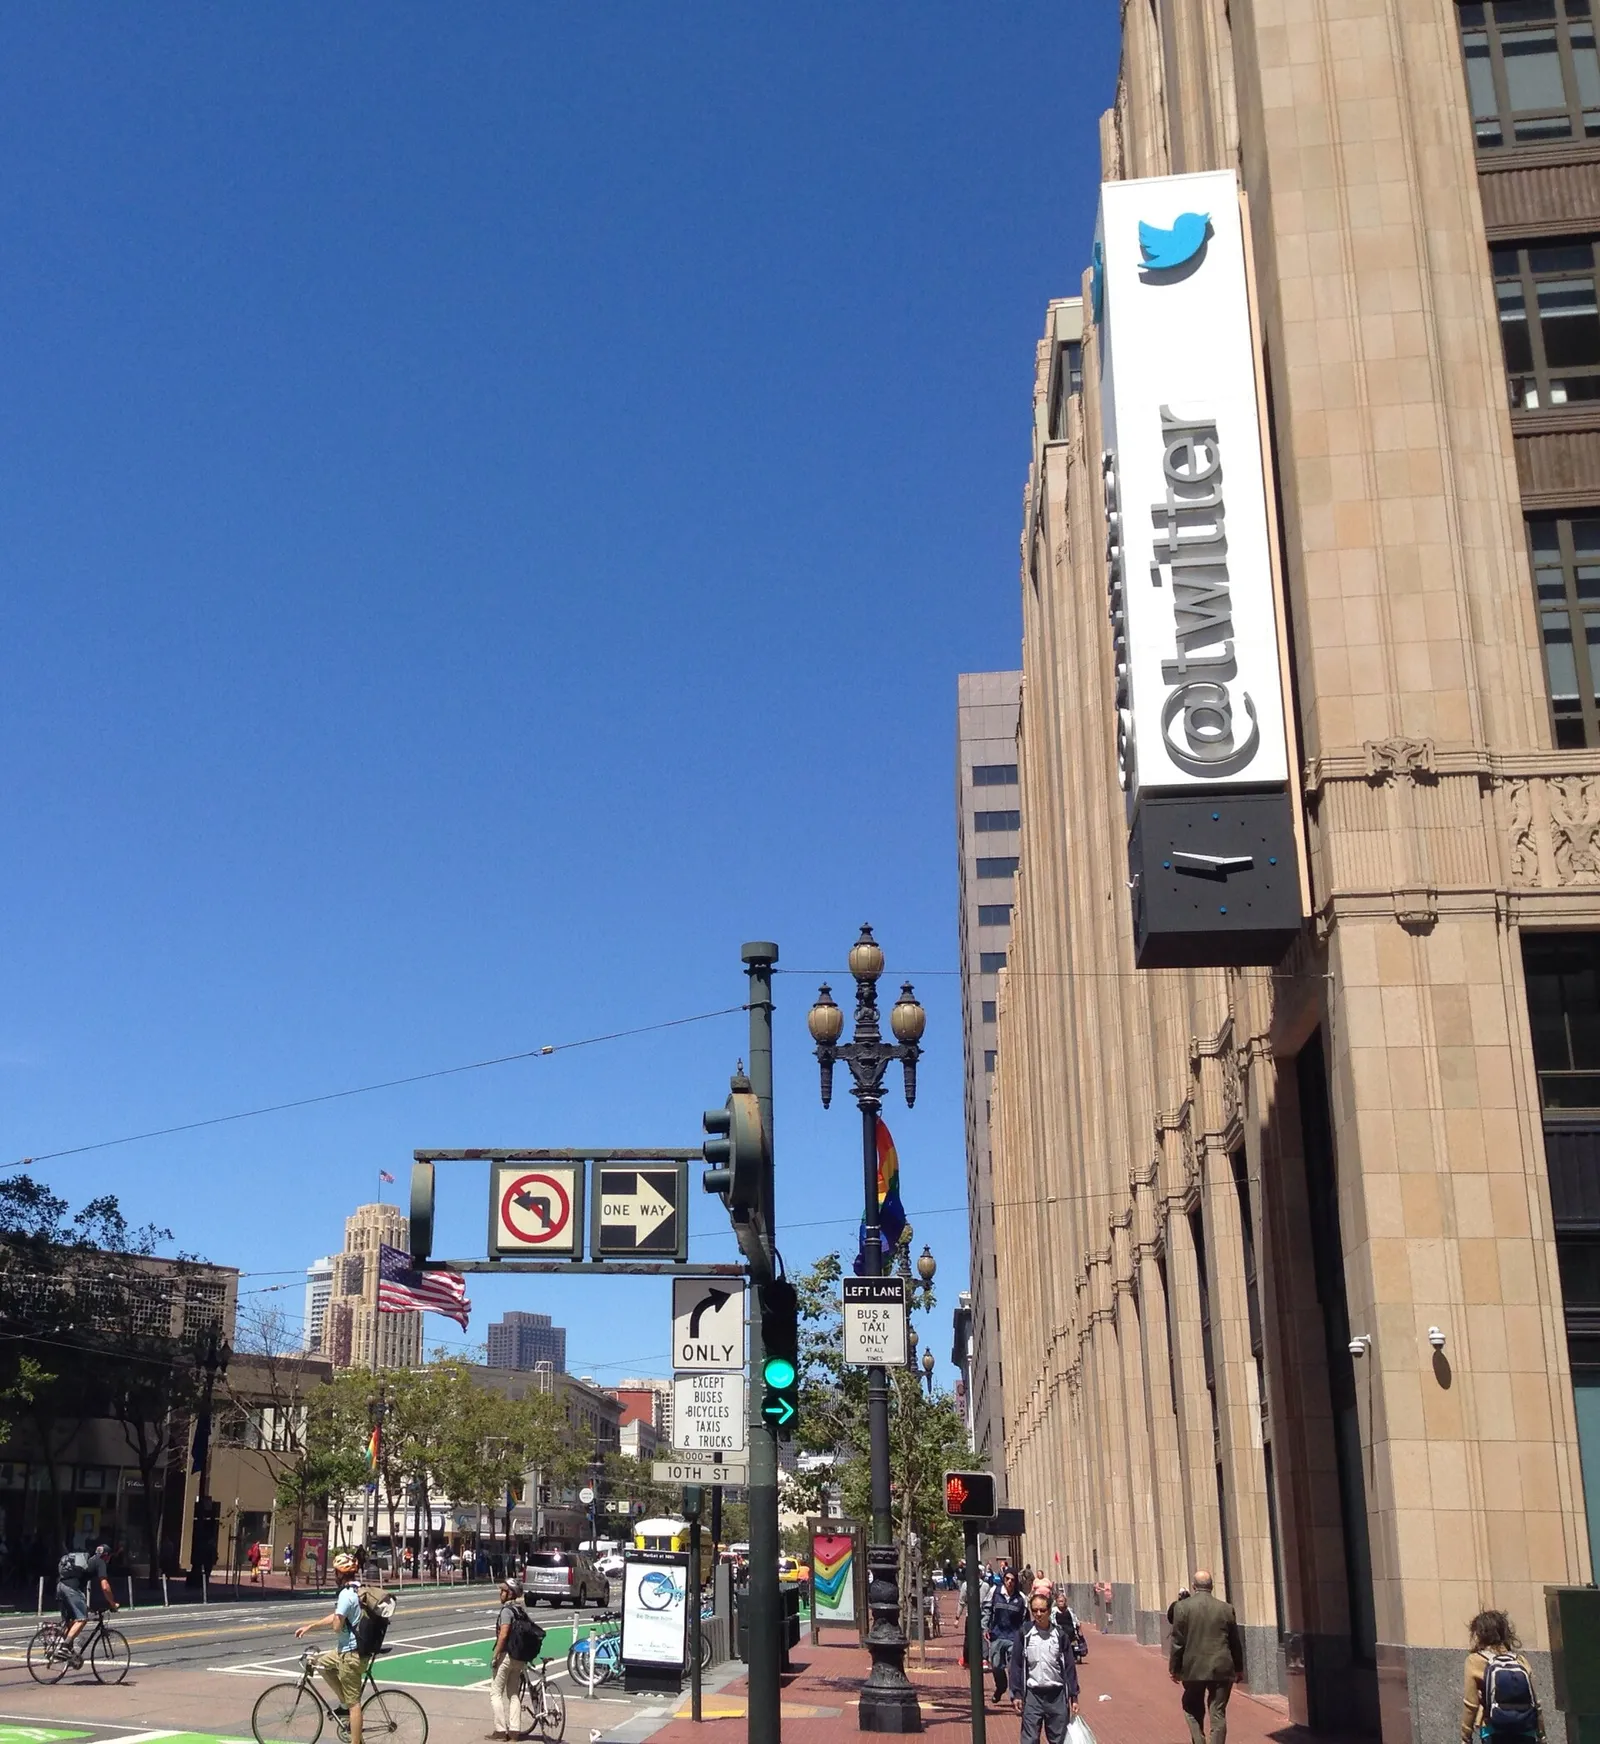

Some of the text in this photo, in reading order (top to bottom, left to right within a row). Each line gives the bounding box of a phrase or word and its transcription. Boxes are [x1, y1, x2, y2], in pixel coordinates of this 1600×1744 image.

[1150, 404, 1258, 768] @twitter
[603, 1204, 667, 1216] ONE WAY
[845, 1286, 902, 1297] LEFT LANE
[857, 1309, 890, 1319] BUS &
[862, 1322, 885, 1332] TAXI
[859, 1334, 889, 1344] ONLY
[682, 1345, 734, 1362] ONLY
[692, 1376, 725, 1388] EXCEPT
[694, 1391, 723, 1403] BUSES
[687, 1405, 729, 1418] BICYCLES
[696, 1420, 720, 1432] TAXIS
[684, 1435, 733, 1448] & TRUCKS
[668, 1466, 729, 1480] 10TH ST
